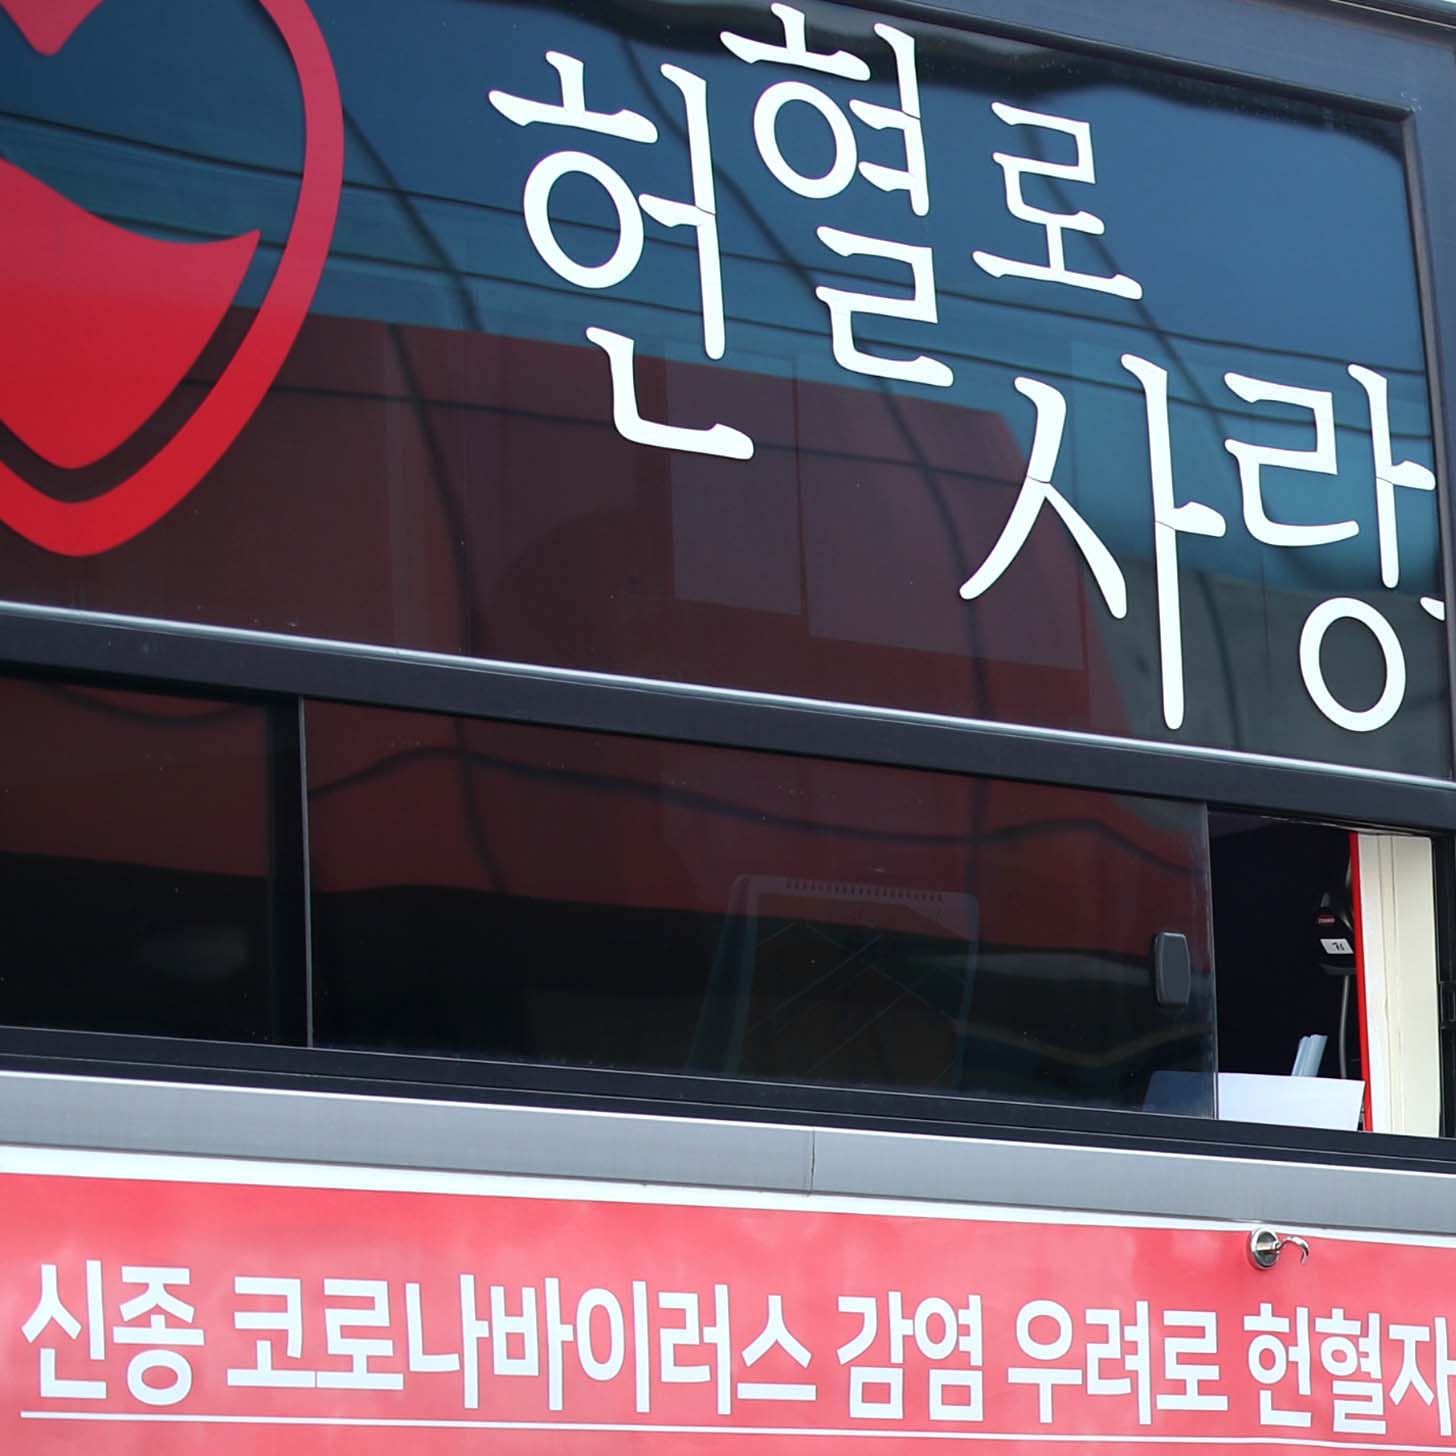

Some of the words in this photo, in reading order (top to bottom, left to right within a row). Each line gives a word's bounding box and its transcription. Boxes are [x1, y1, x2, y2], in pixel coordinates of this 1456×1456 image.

[488, 3, 1142, 460] 헌혈로
[21, 1259, 205, 1406] 신종
[227, 1273, 816, 1415] 코로나바이러스
[836, 1291, 984, 1421] 감염
[1008, 1297, 1228, 1425] 우려로
